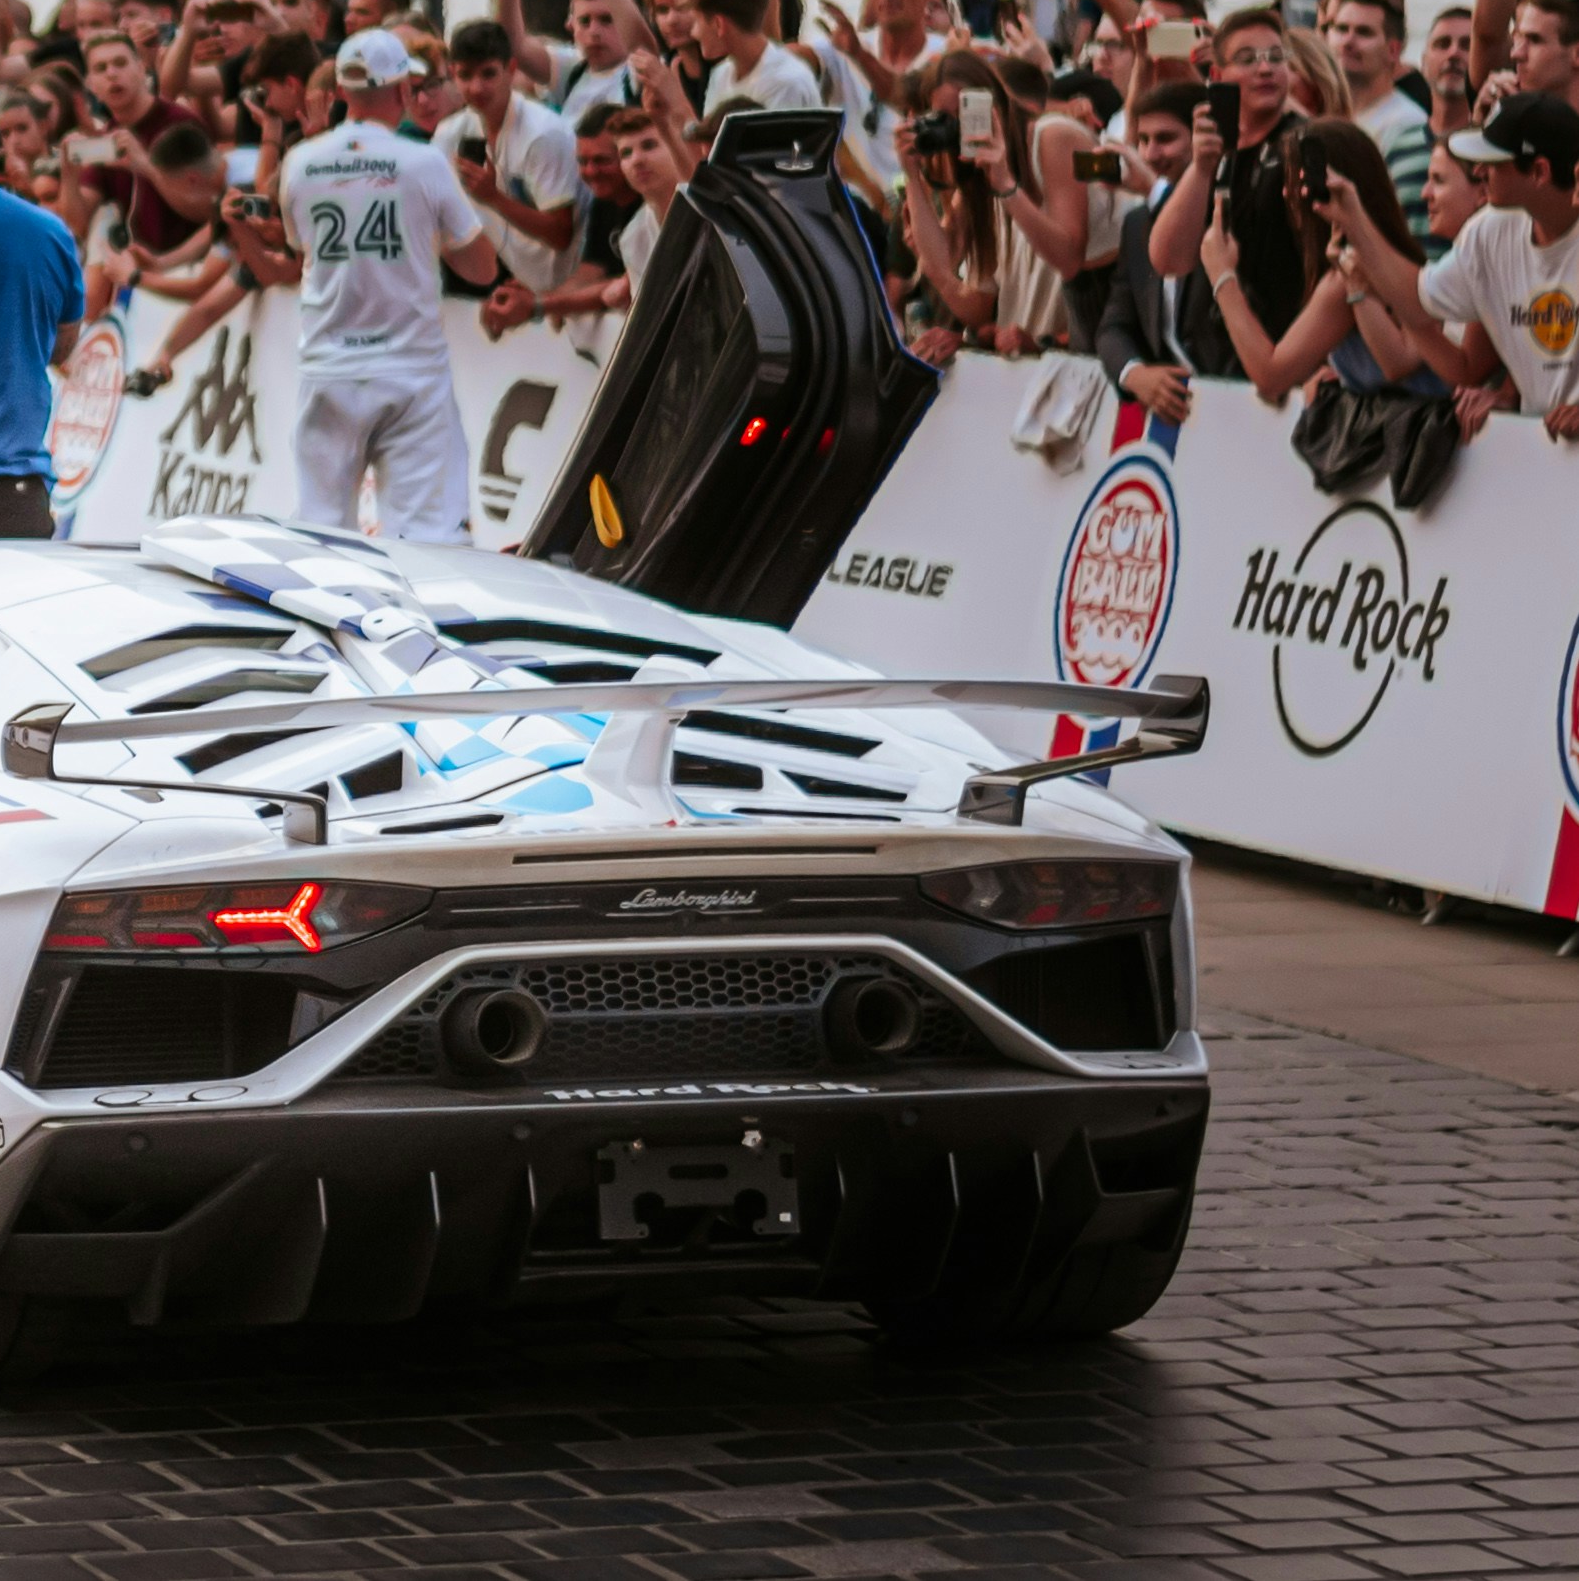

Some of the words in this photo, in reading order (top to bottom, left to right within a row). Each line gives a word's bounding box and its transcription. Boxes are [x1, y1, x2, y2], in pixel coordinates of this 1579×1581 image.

[310, 200, 403, 262] 24
[1087, 504, 1168, 561] GUM
[1072, 557, 1162, 614] BALL
[1064, 611, 1147, 670] 3000
[1233, 548, 1353, 644] Hard
[1339, 565, 1451, 682] Rock
[620, 888, 758, 911] Lamborghini
[544, 1083, 703, 1100] Hard
[706, 1080, 871, 1095] Rock
